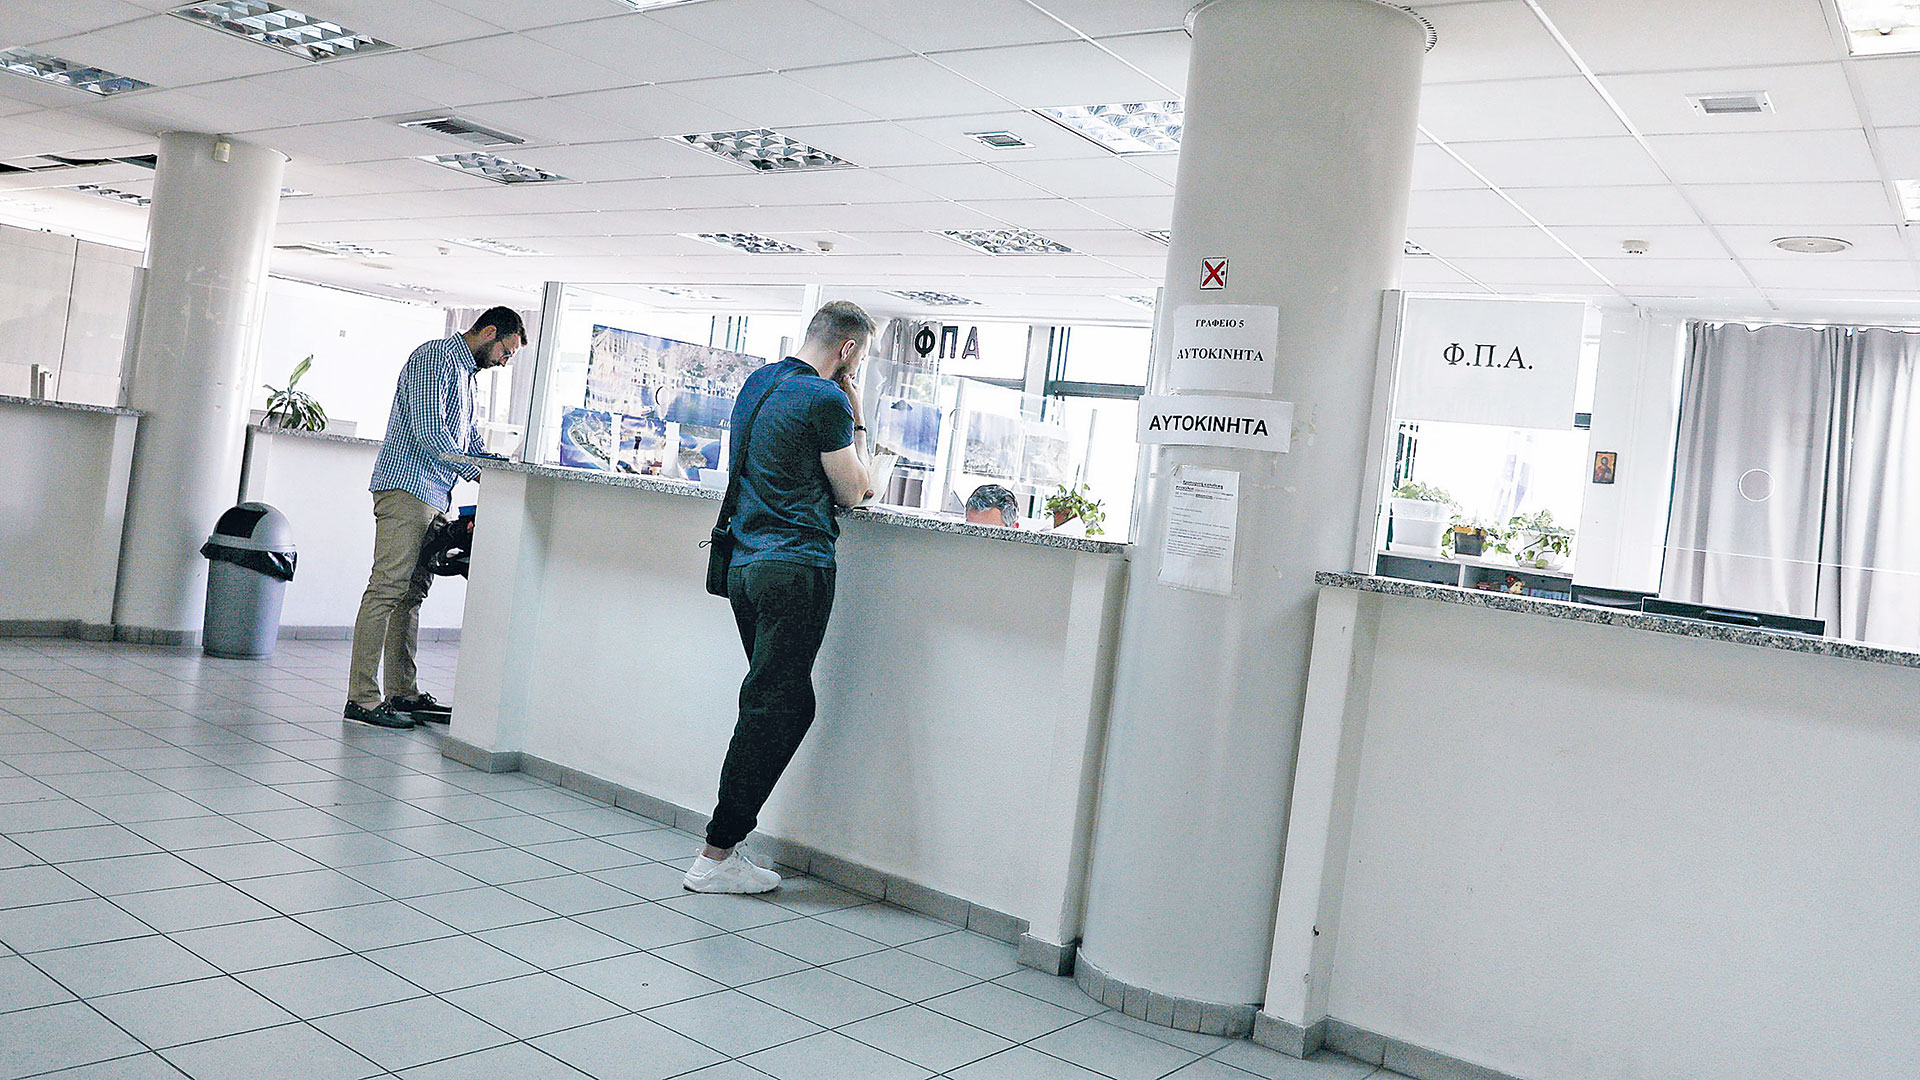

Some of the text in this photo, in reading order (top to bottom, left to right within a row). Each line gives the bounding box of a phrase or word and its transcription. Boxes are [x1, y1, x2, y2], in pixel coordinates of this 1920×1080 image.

[1195, 319, 1245, 328] ΓΡΑΦΕΙΟ 5
[914, 326, 980, 359] ΦΠΑ
[1177, 348, 1264, 361] ΑΥΤΟΚΙΝΗΤΑ
[1443, 343, 1533, 370] Φ.Π.Α.
[1149, 415, 1269, 436] ΑΥΤΟΚΙΝΗΤΑ
